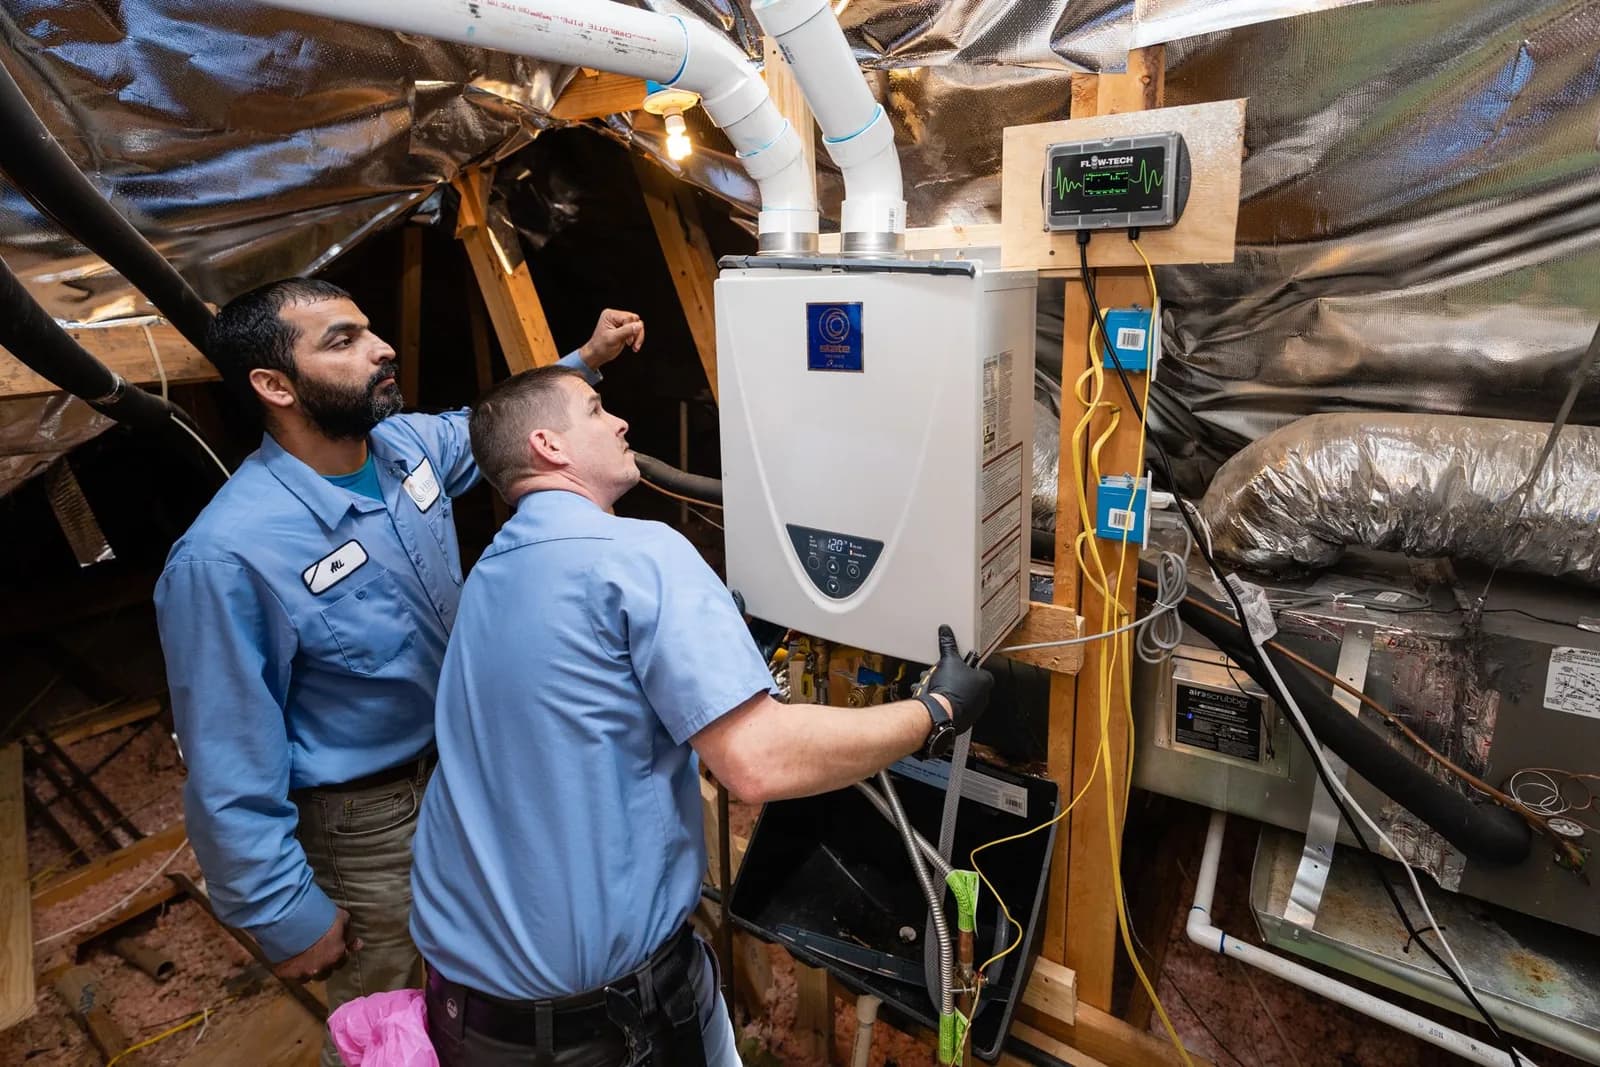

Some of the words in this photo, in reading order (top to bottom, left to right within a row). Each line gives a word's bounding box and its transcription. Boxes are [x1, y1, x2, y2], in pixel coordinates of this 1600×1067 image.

[564, 18, 584, 27] PIPE
[588, 24, 632, 38] CHARLOTTE
[827, 538, 844, 552] 120
